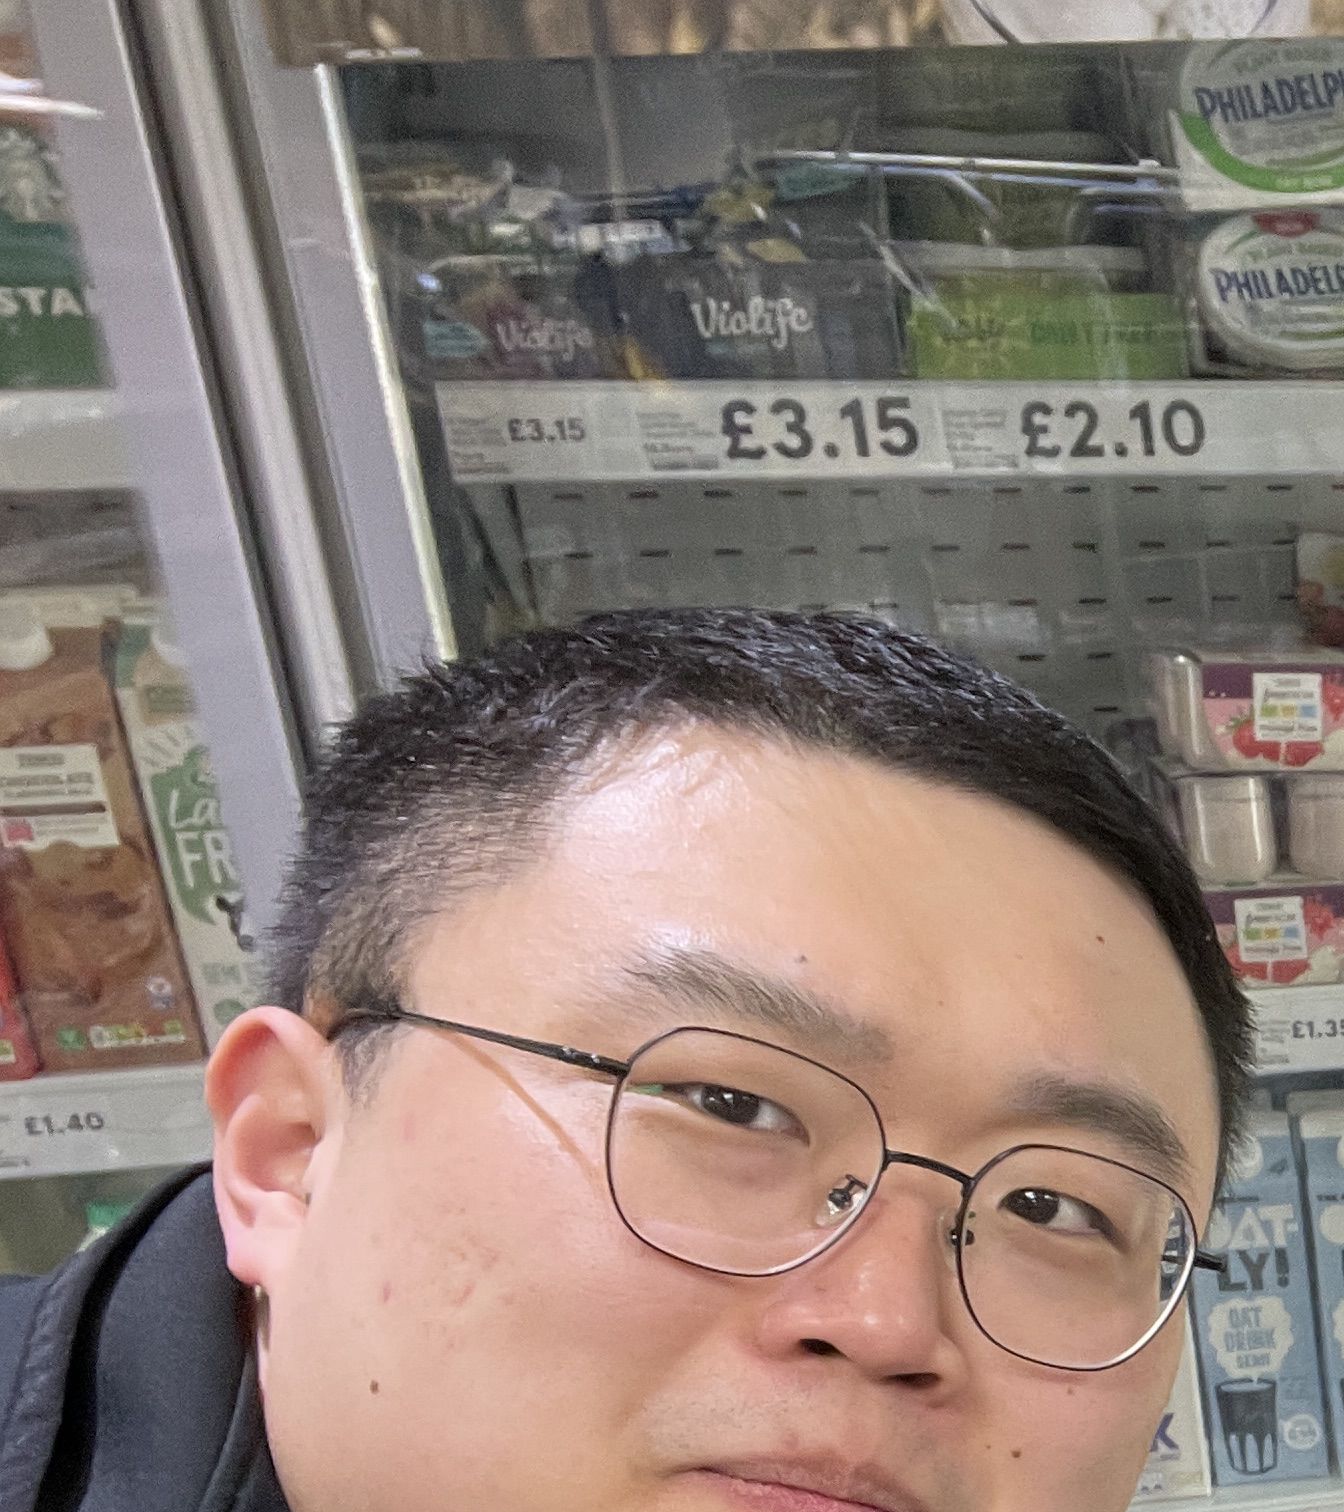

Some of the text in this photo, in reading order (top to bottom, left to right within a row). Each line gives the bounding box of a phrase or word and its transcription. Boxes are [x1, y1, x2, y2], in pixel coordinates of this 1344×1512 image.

[691, 297, 814, 350] Violife
[508, 417, 586, 443] £3.15
[722, 396, 919, 461] £3.15
[1021, 398, 1205, 458] £2.10
